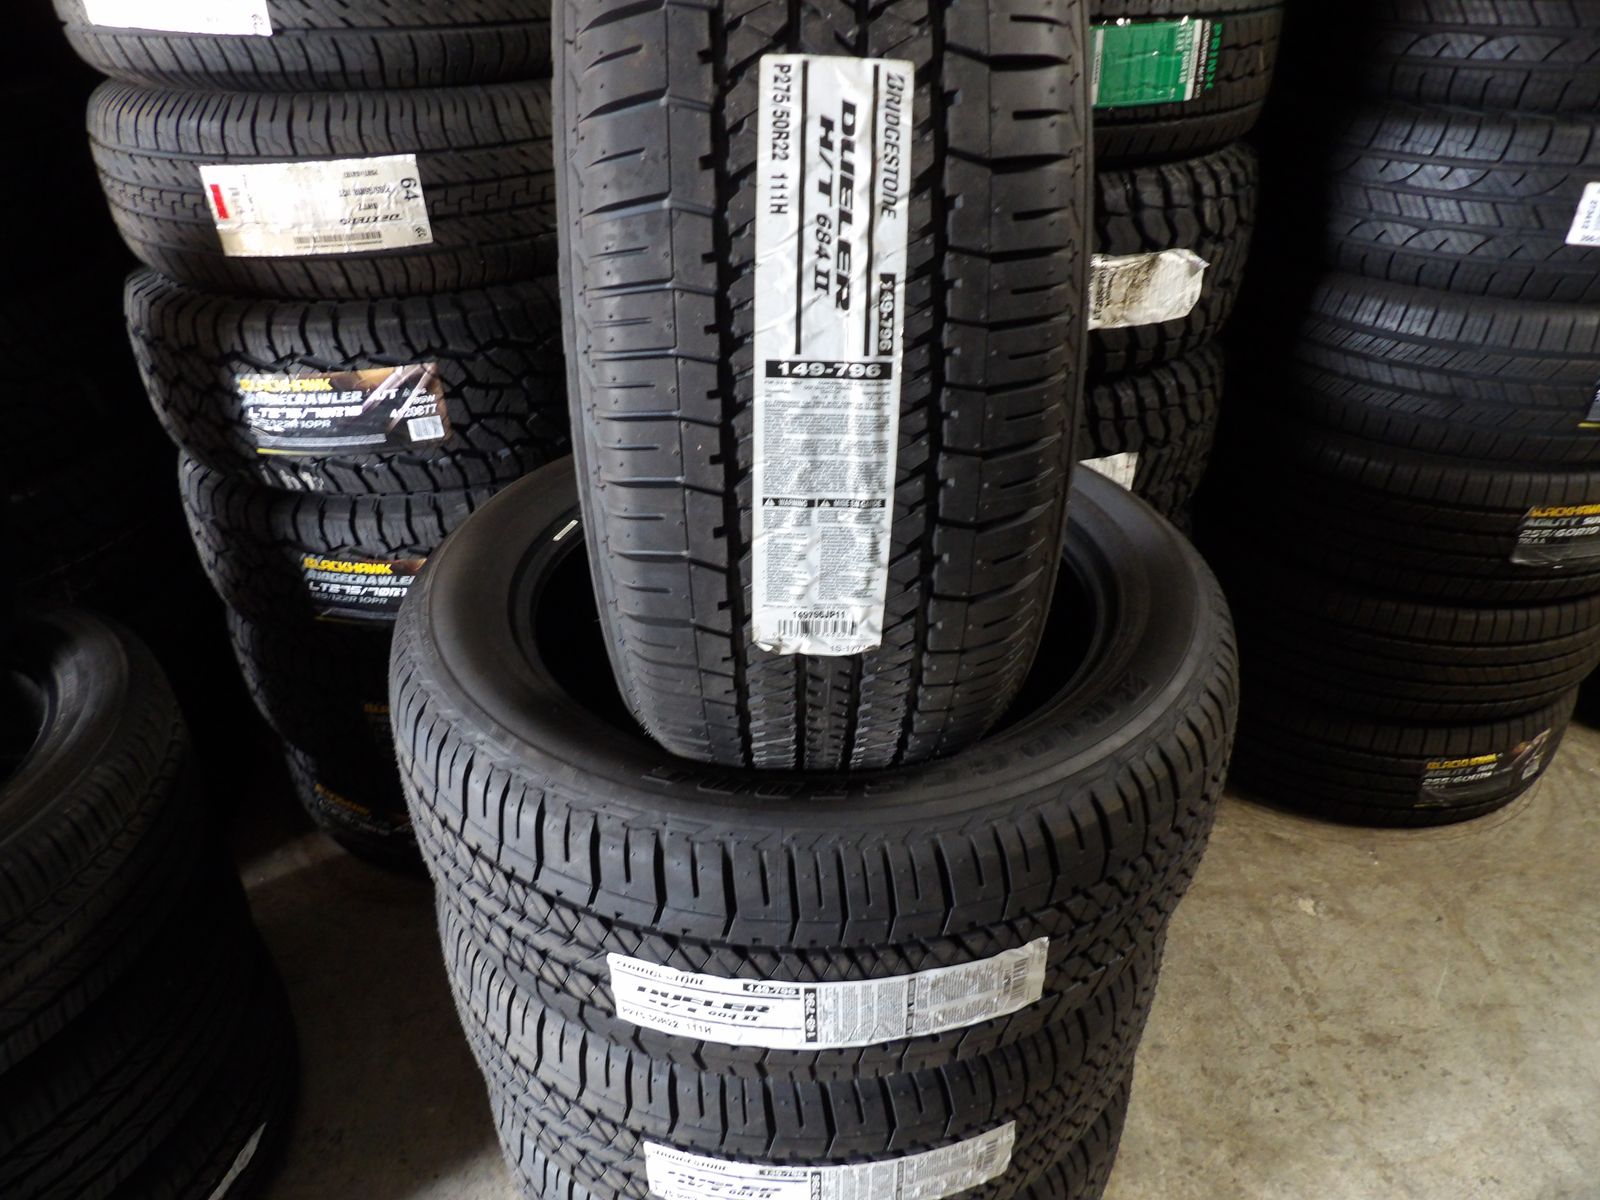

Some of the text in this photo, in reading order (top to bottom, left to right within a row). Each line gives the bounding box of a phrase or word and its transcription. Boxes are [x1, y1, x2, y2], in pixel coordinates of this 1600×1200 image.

[818, 113, 835, 207] H/T
[769, 173, 789, 215] 111H
[835, 98, 857, 311] DUELER
[879, 72, 905, 352] BRIDGESTONE 149-796
[815, 213, 832, 261] 684
[778, 362, 882, 378] 149-796
[303, 557, 393, 575] BLACKHAWK
[305, 569, 416, 587] RIDGECRAWLE
[308, 581, 408, 598] LT275/70R1
[805, 992, 816, 1038] 149-796
